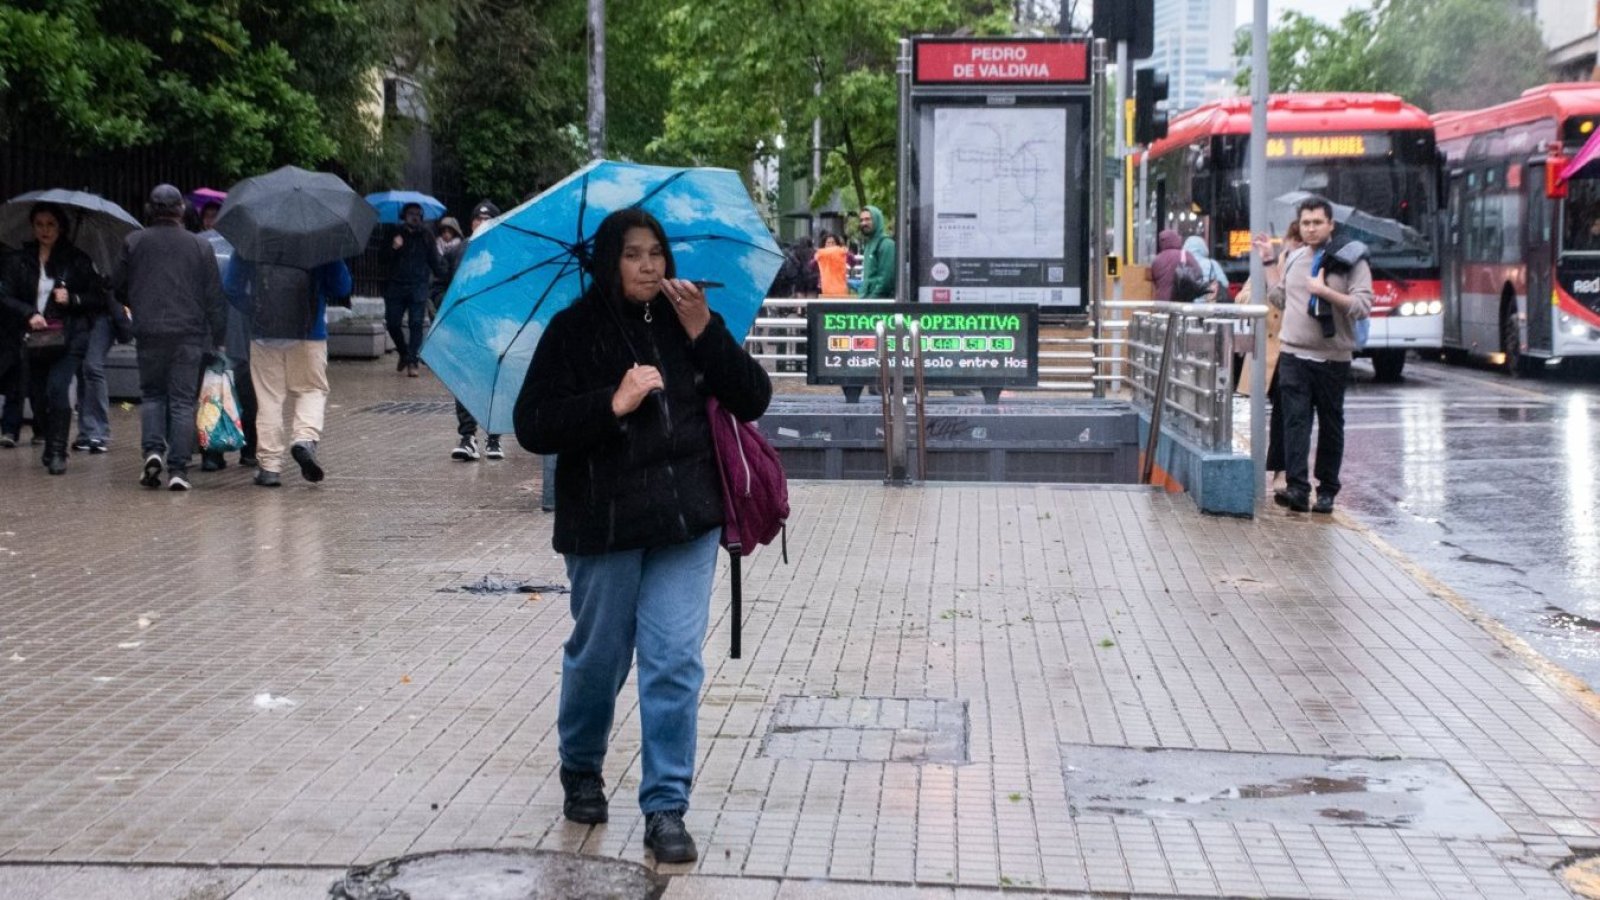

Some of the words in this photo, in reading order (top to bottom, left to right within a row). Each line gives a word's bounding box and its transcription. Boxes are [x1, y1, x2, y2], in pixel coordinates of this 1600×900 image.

[971, 47, 1027, 60] PEDRO
[953, 64, 975, 77] DE
[978, 64, 1049, 77] VALDIVIA
[920, 315, 1020, 330] OPERATIVA
[825, 356, 841, 367] L2
[924, 357, 953, 368] solo
[959, 357, 999, 368] entre
[1004, 357, 1028, 368] Hos
